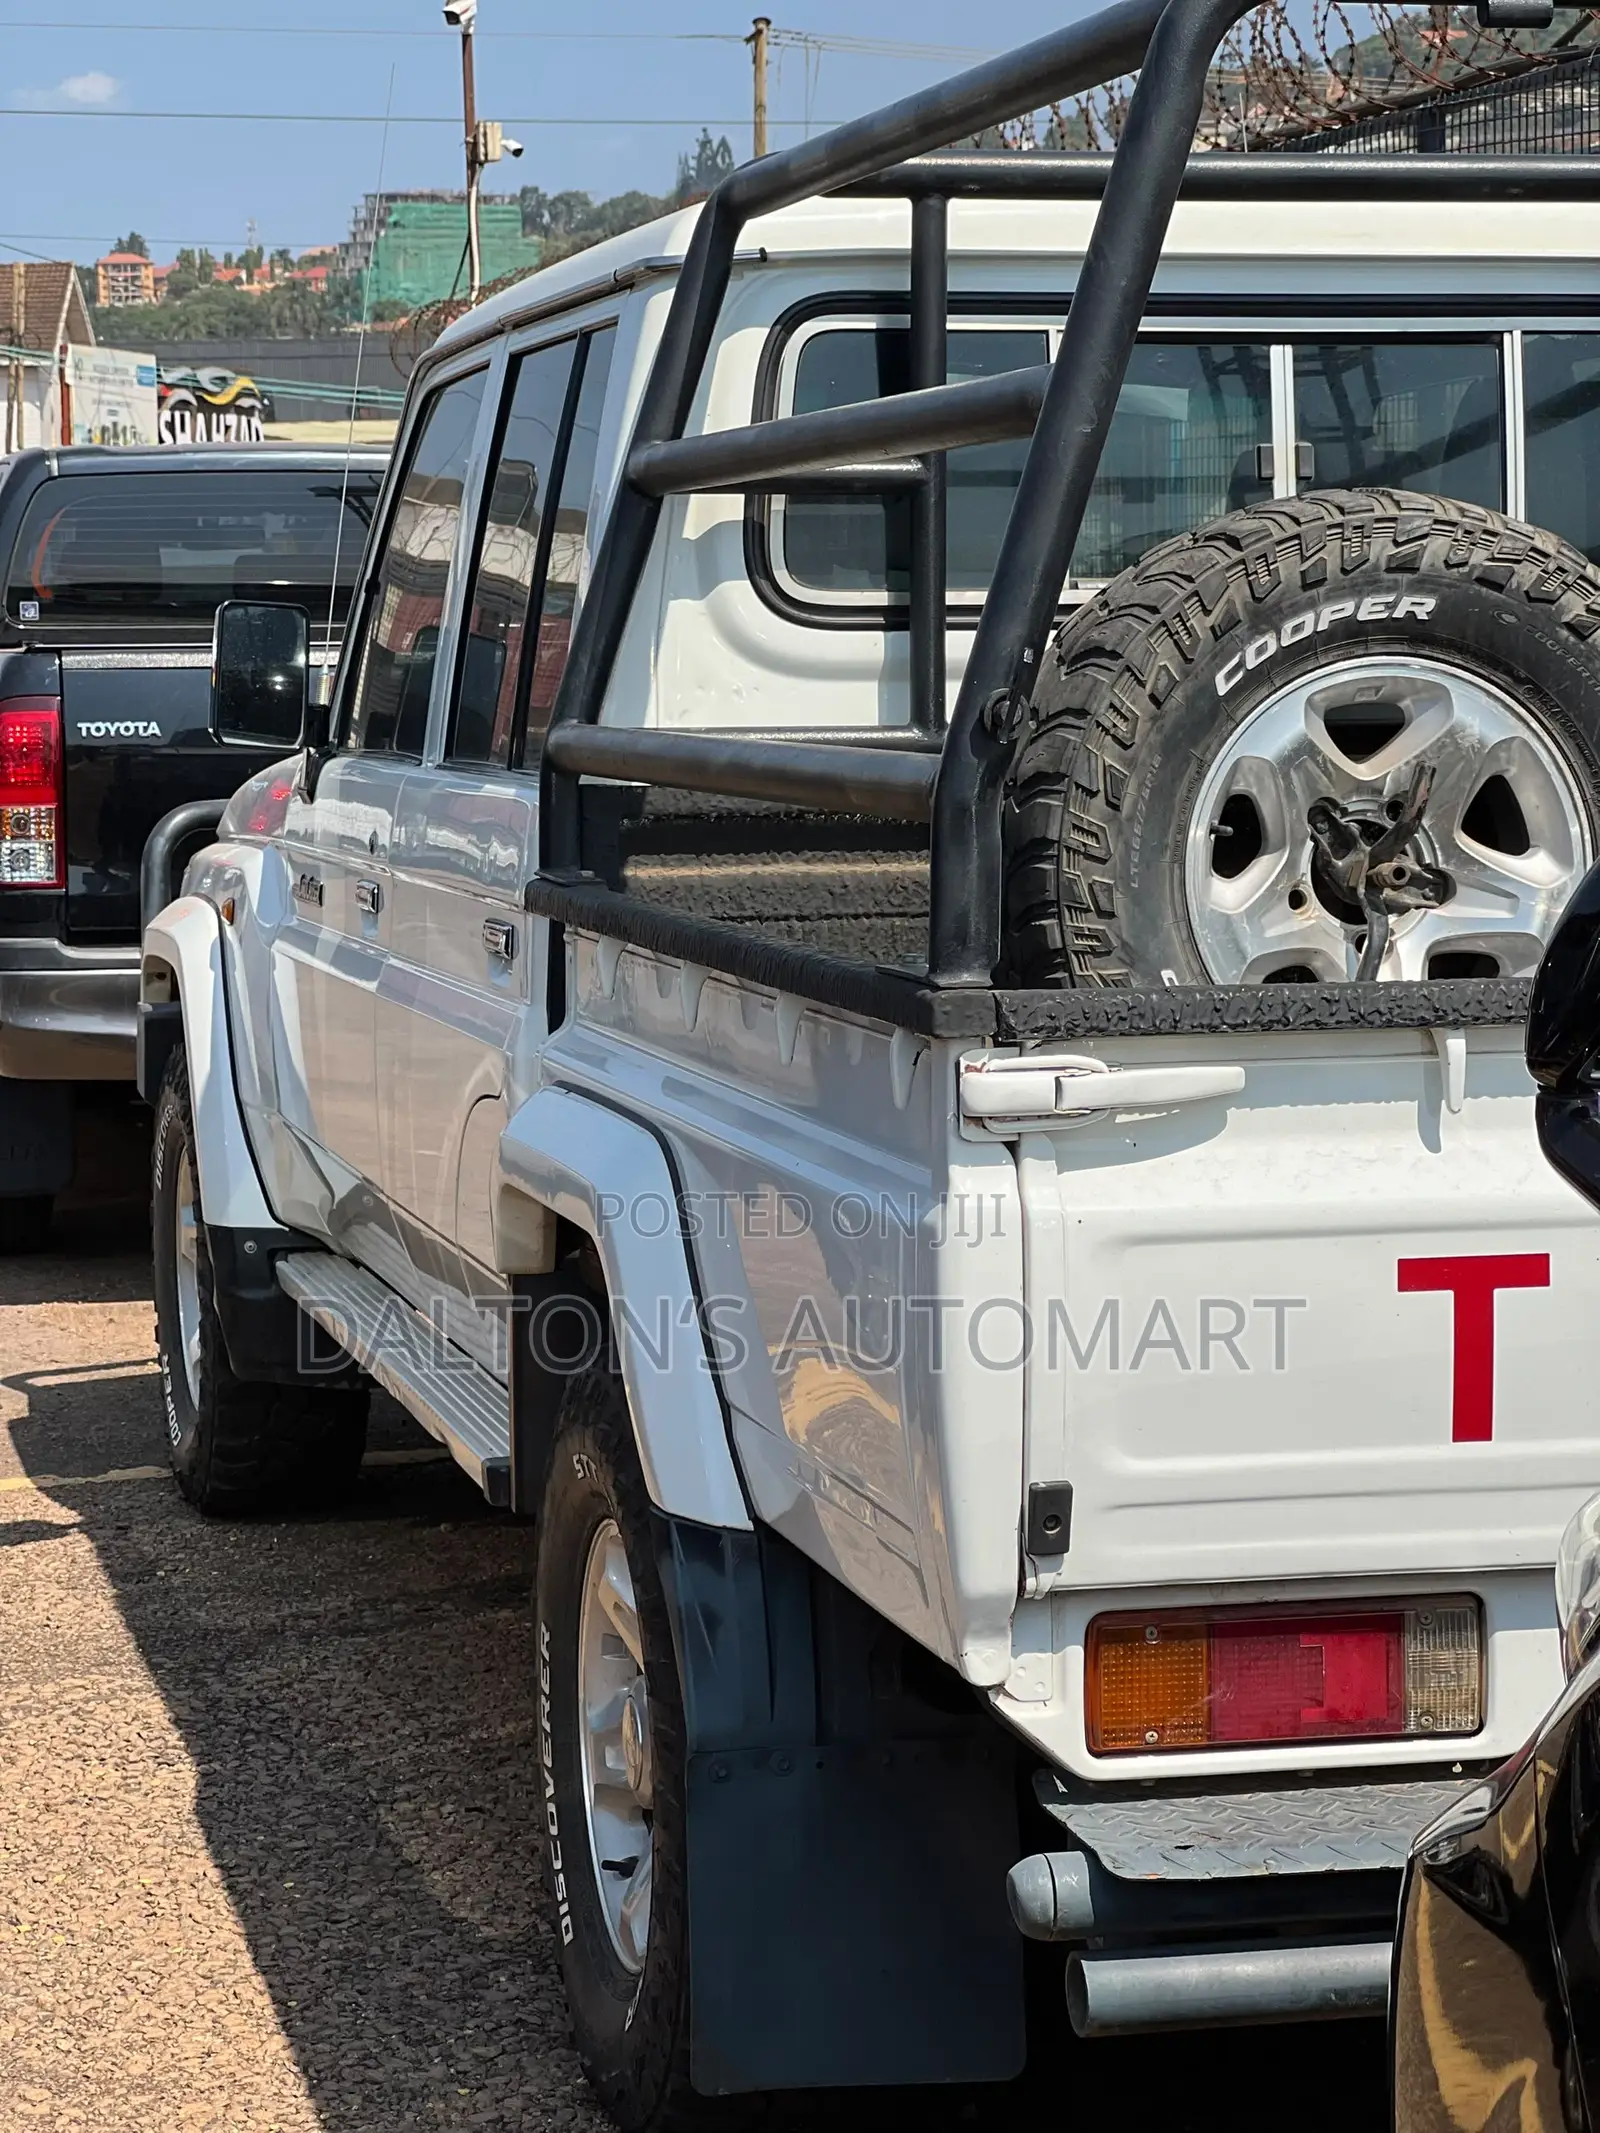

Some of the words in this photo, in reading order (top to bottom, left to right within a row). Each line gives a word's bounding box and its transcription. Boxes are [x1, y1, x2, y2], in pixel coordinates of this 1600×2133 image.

[1214, 595, 1437, 697] COOPER
[77, 721, 162, 738] TOYOTA
[1397, 1252, 1551, 1443] T
[162, 1353, 182, 1447] COOPER
[541, 1621, 574, 1947] DISCOVERER
